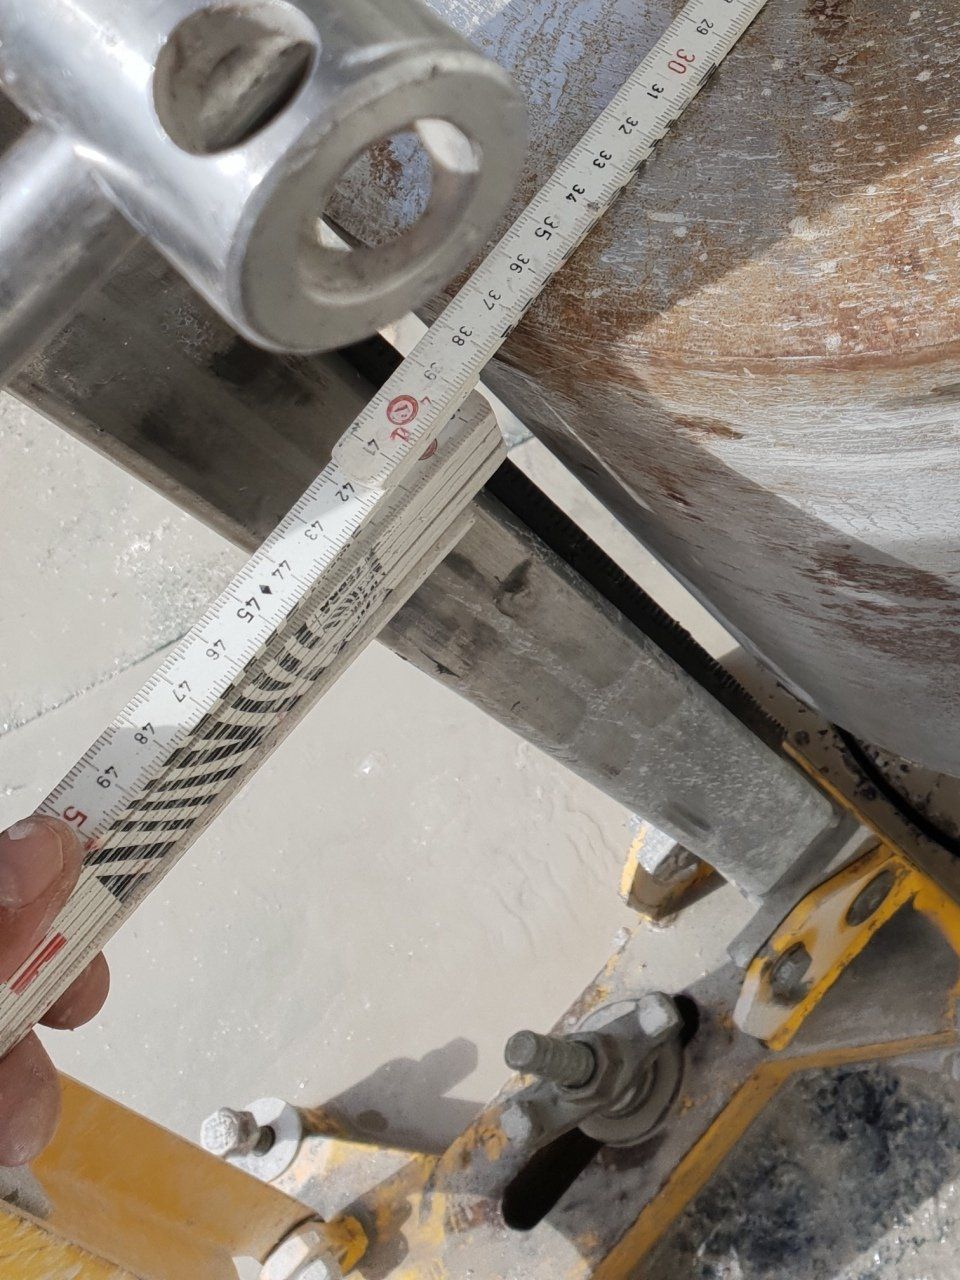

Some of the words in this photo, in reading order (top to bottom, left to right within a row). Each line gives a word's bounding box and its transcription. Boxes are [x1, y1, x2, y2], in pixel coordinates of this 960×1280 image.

[696, 18, 714, 36] 29
[667, 48, 696, 75] 30
[646, 83, 665, 99] 31
[618, 116, 639, 135] 32
[593, 150, 613, 169] 33
[565, 184, 586, 203] 34
[534, 215, 559, 241] 35
[509, 253, 530, 274] 36
[483, 289, 502, 311] 37
[452, 325, 473, 347] 38
[423, 361, 445, 381] 39
[362, 438, 380, 456] 41
[335, 481, 356, 502] 42
[304, 520, 325, 541] 43
[271, 559, 292, 580] 44
[236, 596, 261, 623] 45
[205, 639, 226, 661] 46
[172, 680, 192, 703] 47
[134, 722, 156, 745] 48
[96, 765, 119, 789] 49
[62, 806, 88, 828] 5
